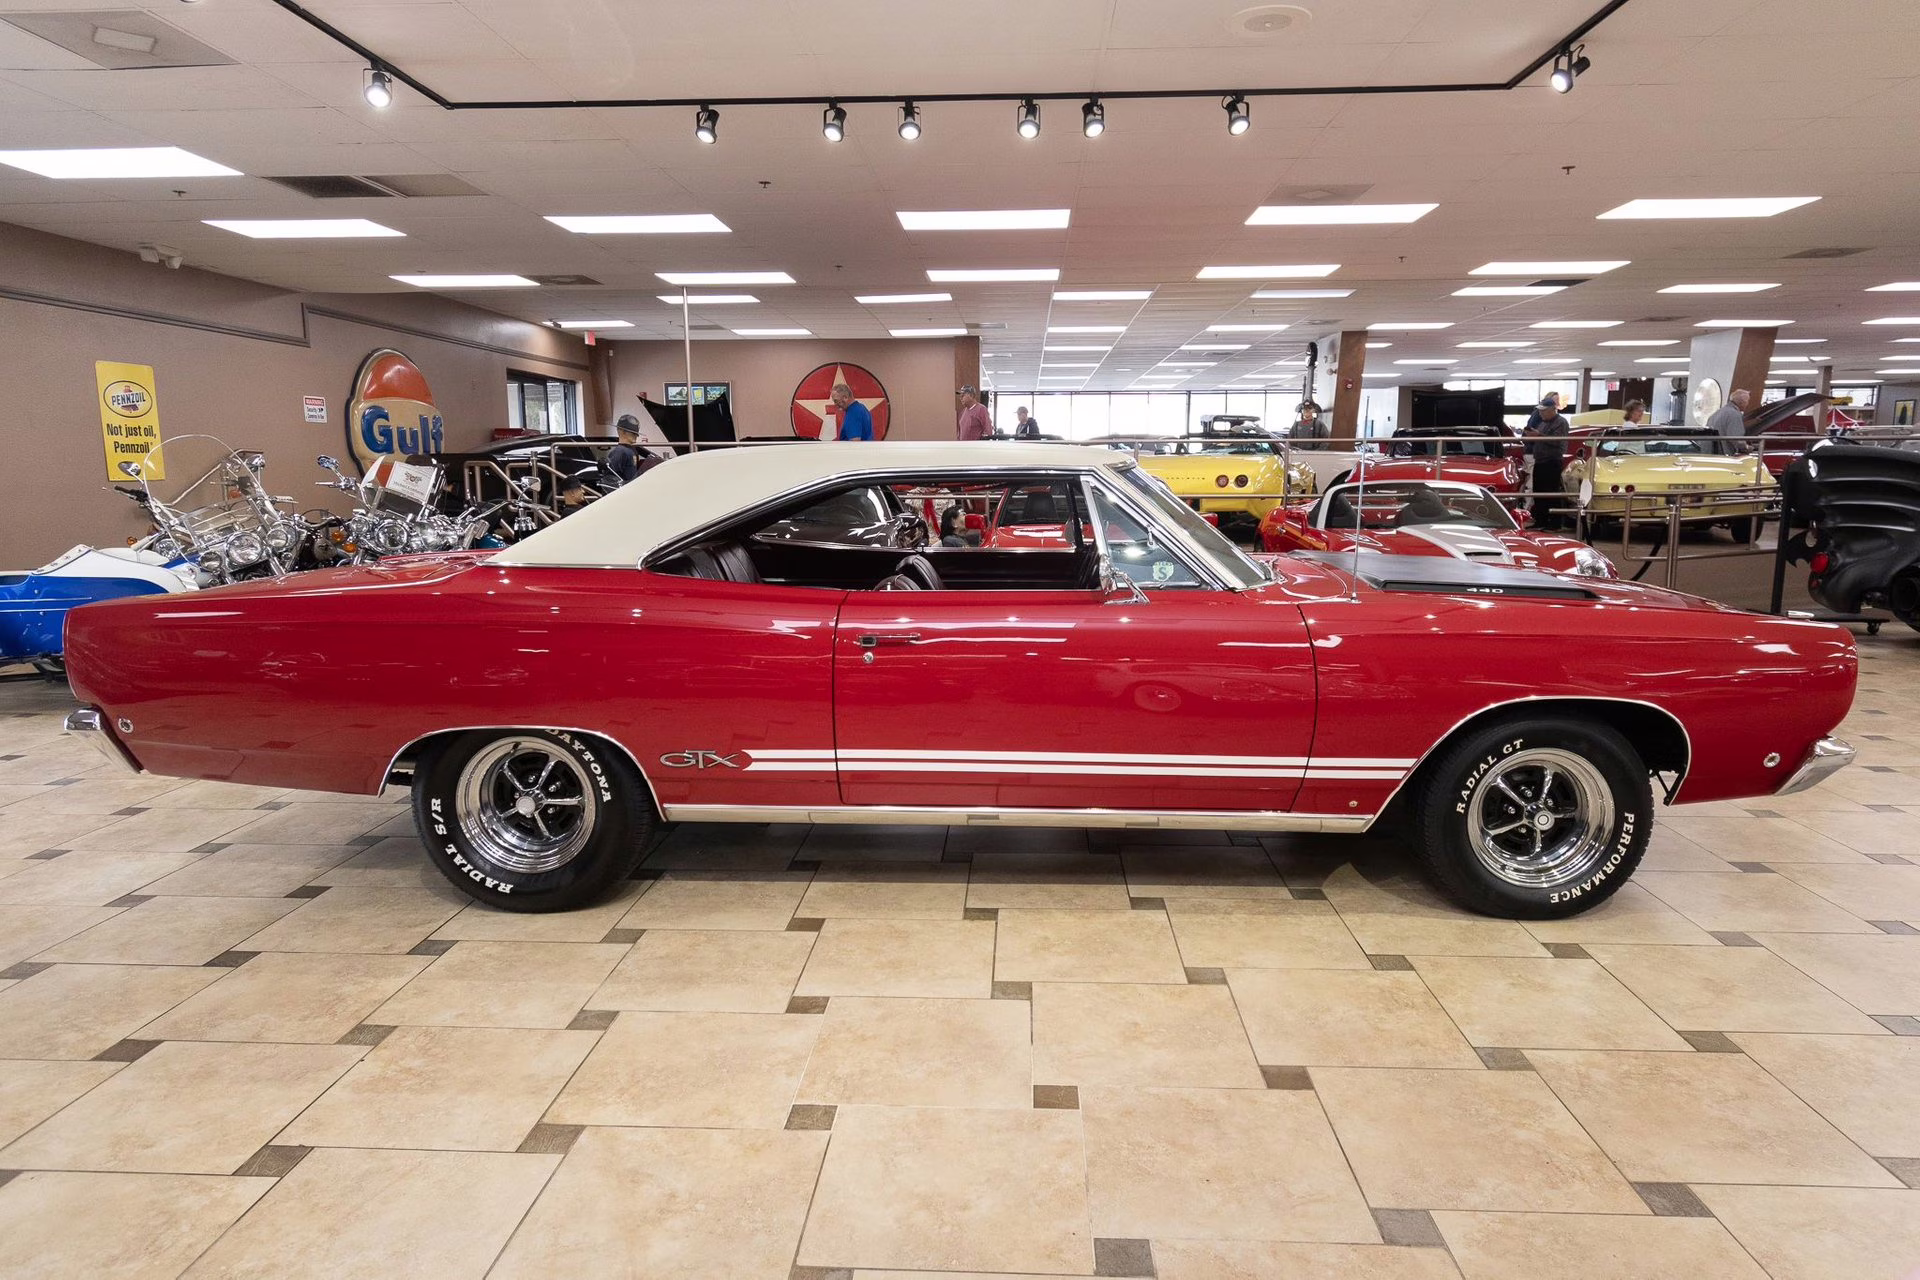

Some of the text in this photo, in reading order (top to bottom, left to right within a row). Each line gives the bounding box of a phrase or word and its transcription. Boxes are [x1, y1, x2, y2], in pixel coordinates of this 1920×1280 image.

[111, 391, 146, 406] PENNZOIL
[106, 423, 157, 439] Not just oil,
[361, 405, 443, 455] Gulf
[660, 749, 740, 769] GTX
[1456, 739, 1524, 814] RADIAL GT
[431, 798, 514, 894] RADIAL S/R
[1550, 812, 1635, 904] PERFORMANCE
